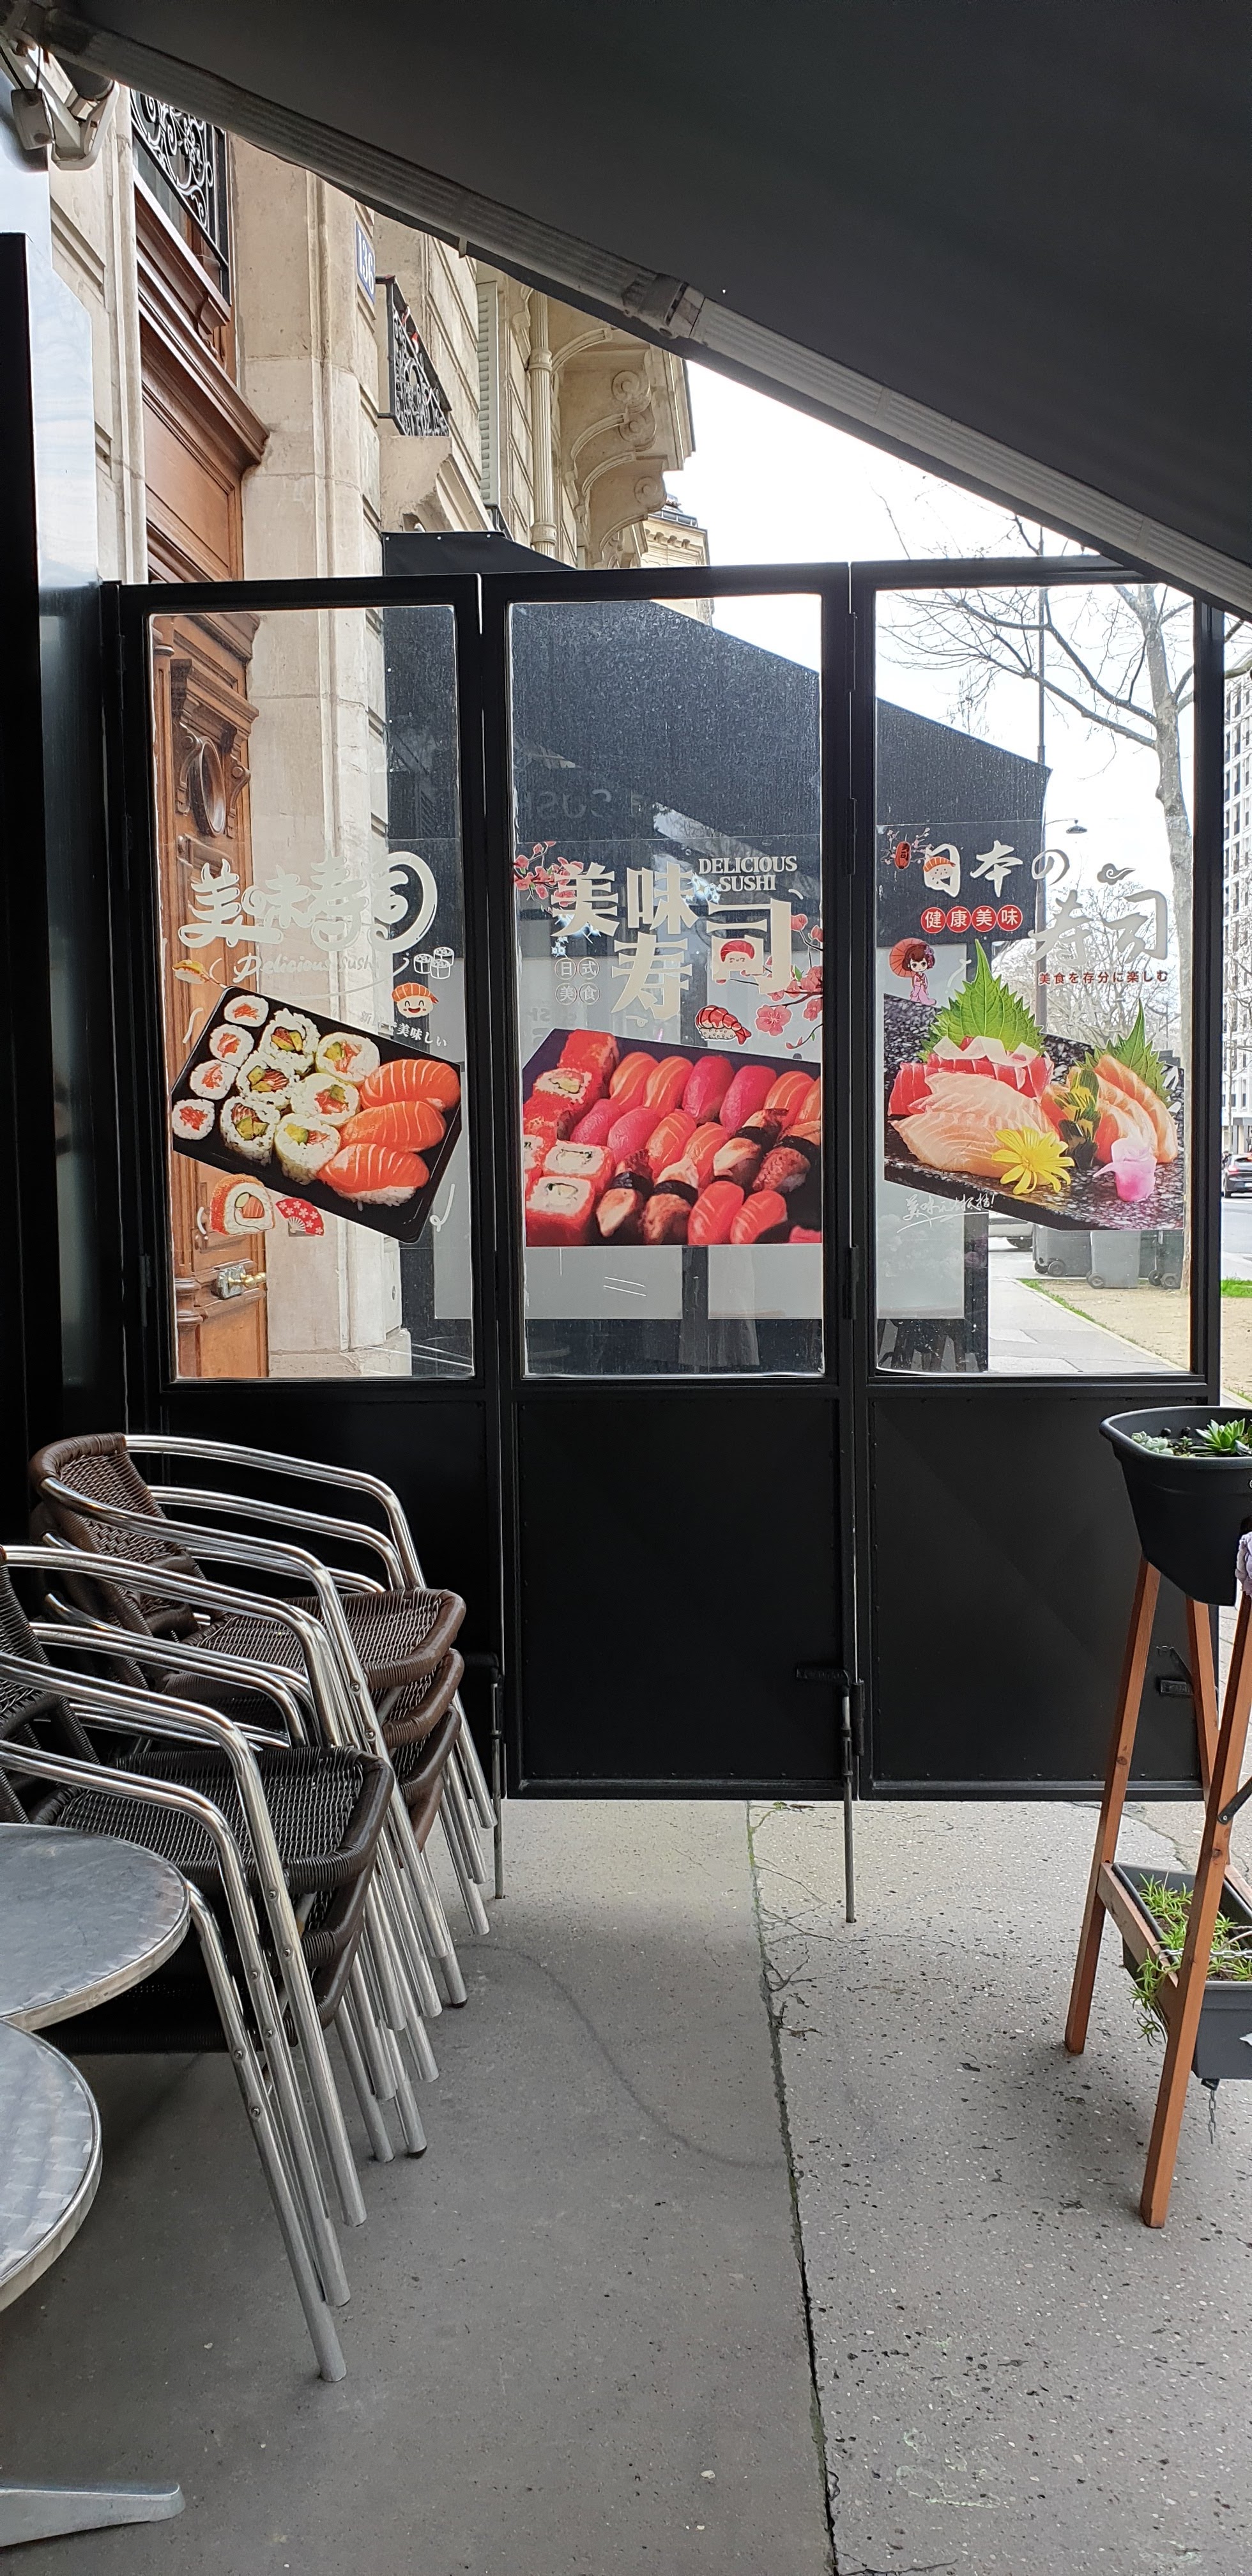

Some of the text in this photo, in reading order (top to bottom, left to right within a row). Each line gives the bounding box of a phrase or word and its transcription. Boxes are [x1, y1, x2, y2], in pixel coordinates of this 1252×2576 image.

[357, 230, 374, 295] 136
[698, 856, 797, 875] DELICIOUS
[923, 840, 1070, 898] 日本の
[719, 875, 776, 892] SUSHI
[924, 908, 1019, 928] 健康美味
[1027, 890, 1168, 967] 寿司
[233, 953, 332, 983] Delicious
[561, 961, 596, 976] 日式
[1039, 970, 1168, 985] 美食を存分に楽しむ
[560, 985, 597, 1002] 美食
